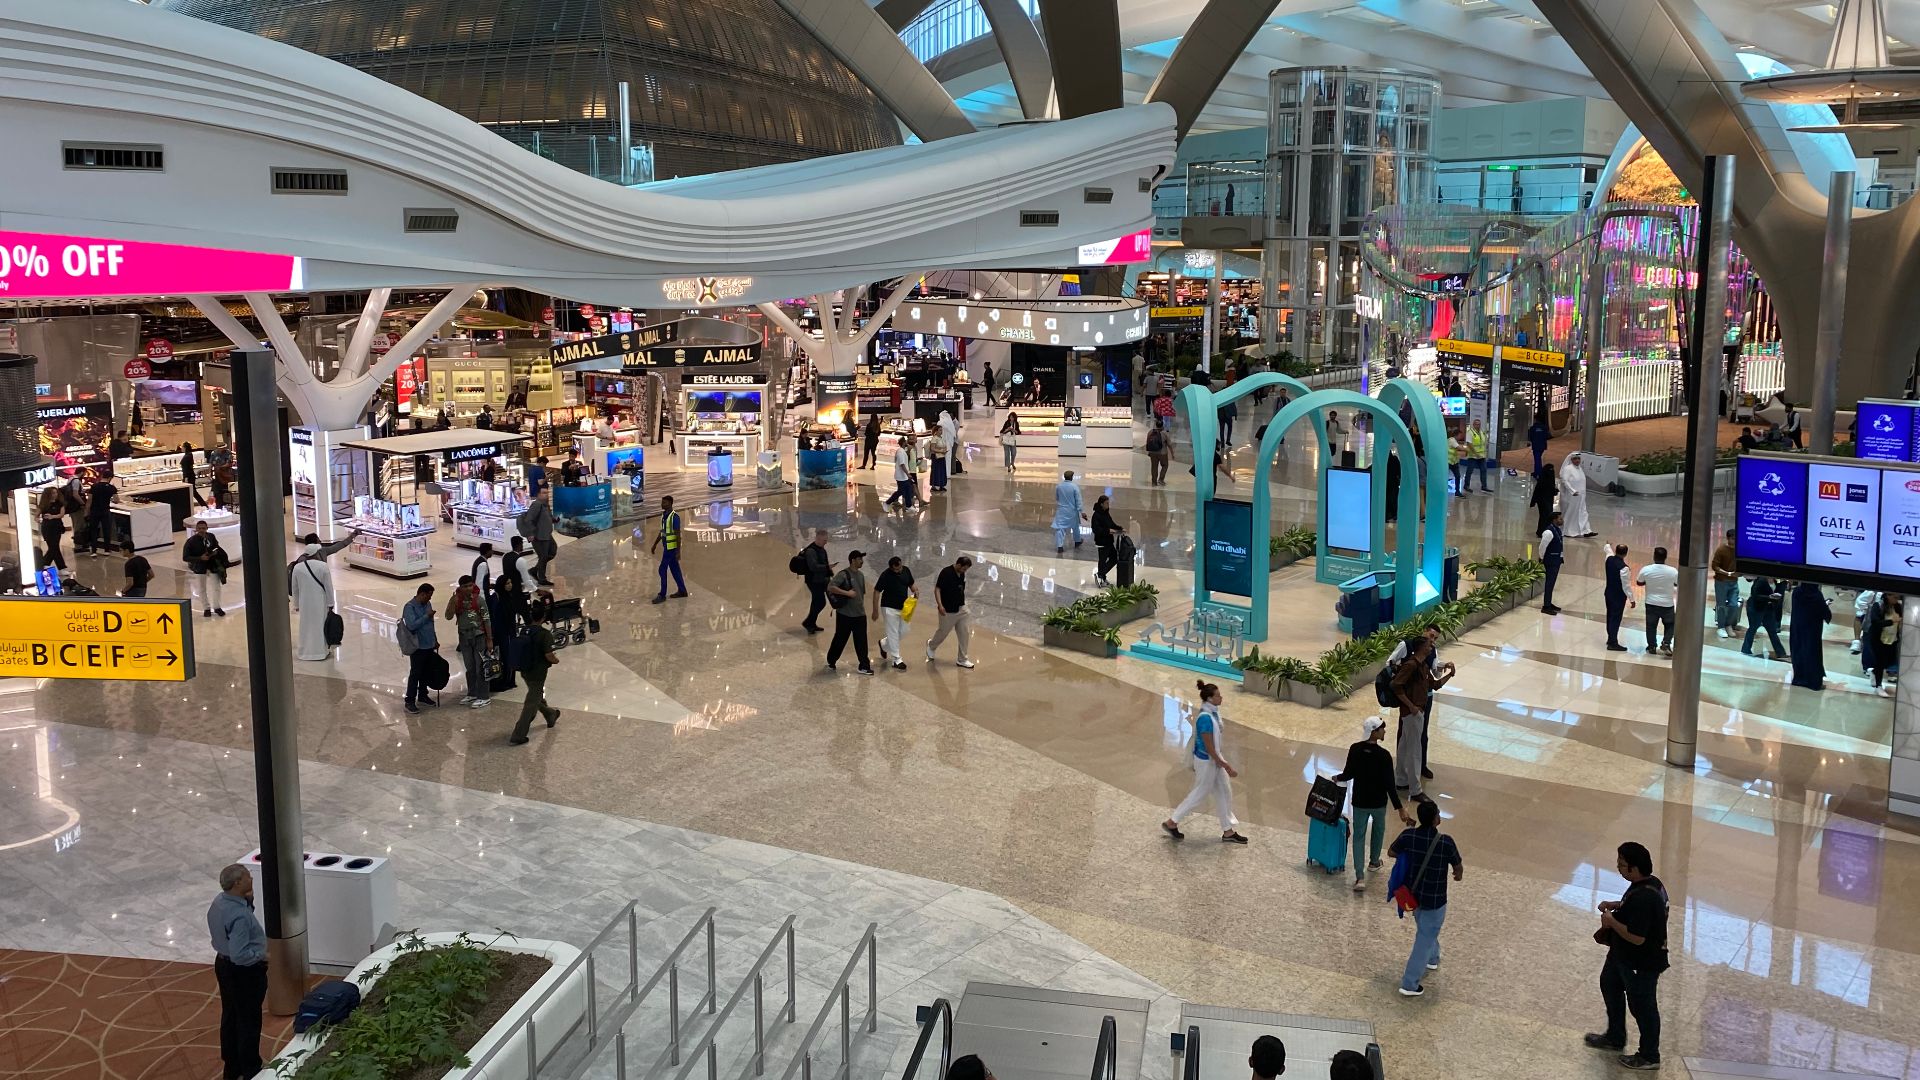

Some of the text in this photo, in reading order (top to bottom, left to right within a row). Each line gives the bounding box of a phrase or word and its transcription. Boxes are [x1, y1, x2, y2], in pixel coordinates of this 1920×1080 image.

[62, 244, 124, 276] OFF
[638, 329, 661, 347] AJMAL
[1000, 327, 1035, 341] CHANEL
[149, 346, 170, 355] 20%
[553, 341, 605, 364] AJMAL
[1449, 342, 1455, 350] D
[622, 351, 657, 366] MAL
[703, 347, 754, 363] AJMAL
[127, 367, 148, 375] 20%
[720, 375, 754, 384] LAUDER
[451, 447, 489, 460] LANCÔME
[24, 466, 55, 486] DIOR
[1820, 516, 1865, 531] GATE A
[64, 610, 99, 621] البوابات
[103, 610, 122, 633] D
[67, 622, 100, 633] Gates
[0, 643, 27, 655] البوابا
[32, 643, 125, 668] B C E F
